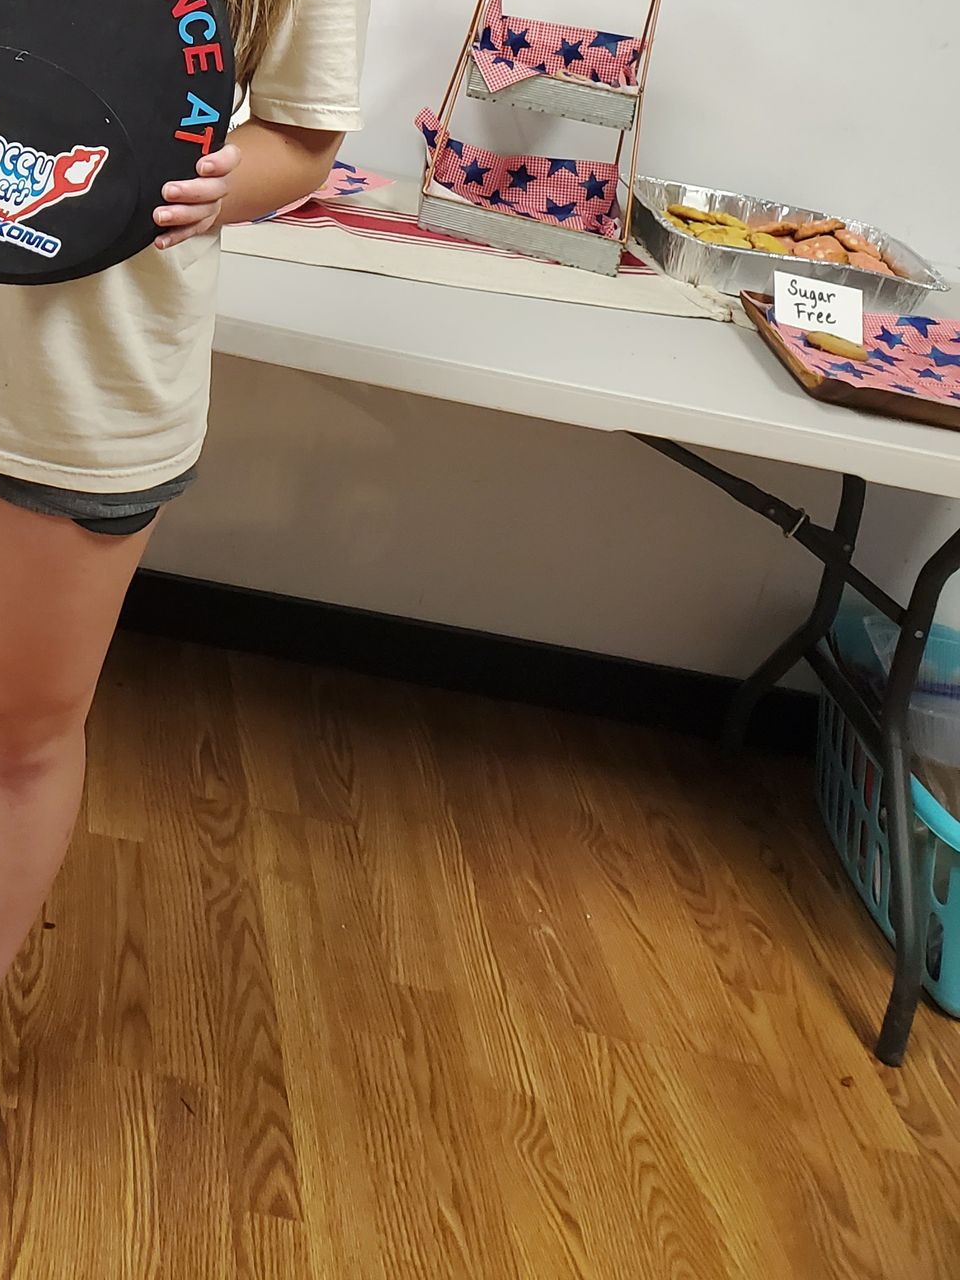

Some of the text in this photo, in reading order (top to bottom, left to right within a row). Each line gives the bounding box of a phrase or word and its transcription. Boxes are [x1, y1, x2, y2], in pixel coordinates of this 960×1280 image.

[174, 91, 220, 155] AT
[787, 278, 837, 309] Sugar
[794, 303, 837, 325] Free
